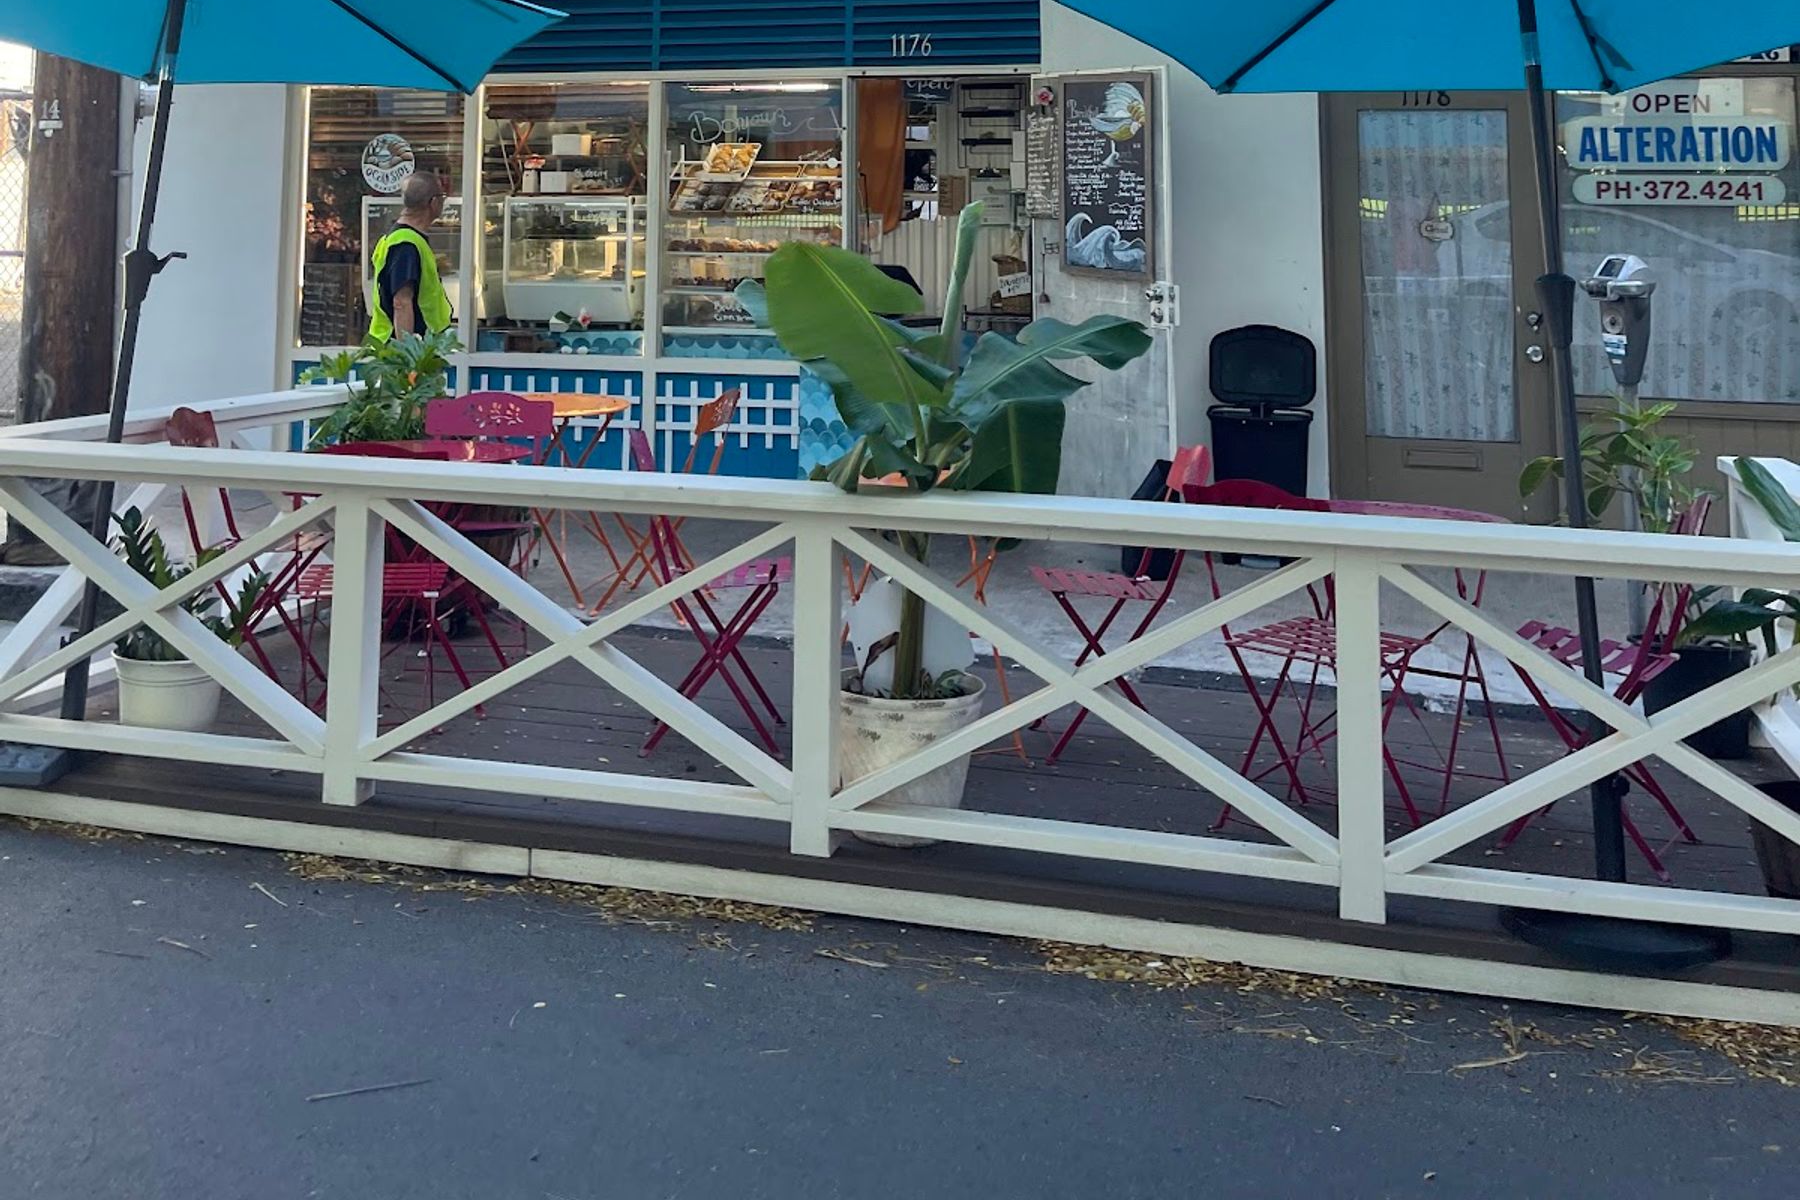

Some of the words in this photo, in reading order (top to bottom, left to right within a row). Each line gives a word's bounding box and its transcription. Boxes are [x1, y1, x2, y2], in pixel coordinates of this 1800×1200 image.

[891, 33, 932, 57] 1176
[40, 99, 61, 120] 14
[1632, 93, 1711, 113] OPEN
[1579, 126, 1778, 163] ALTERATION
